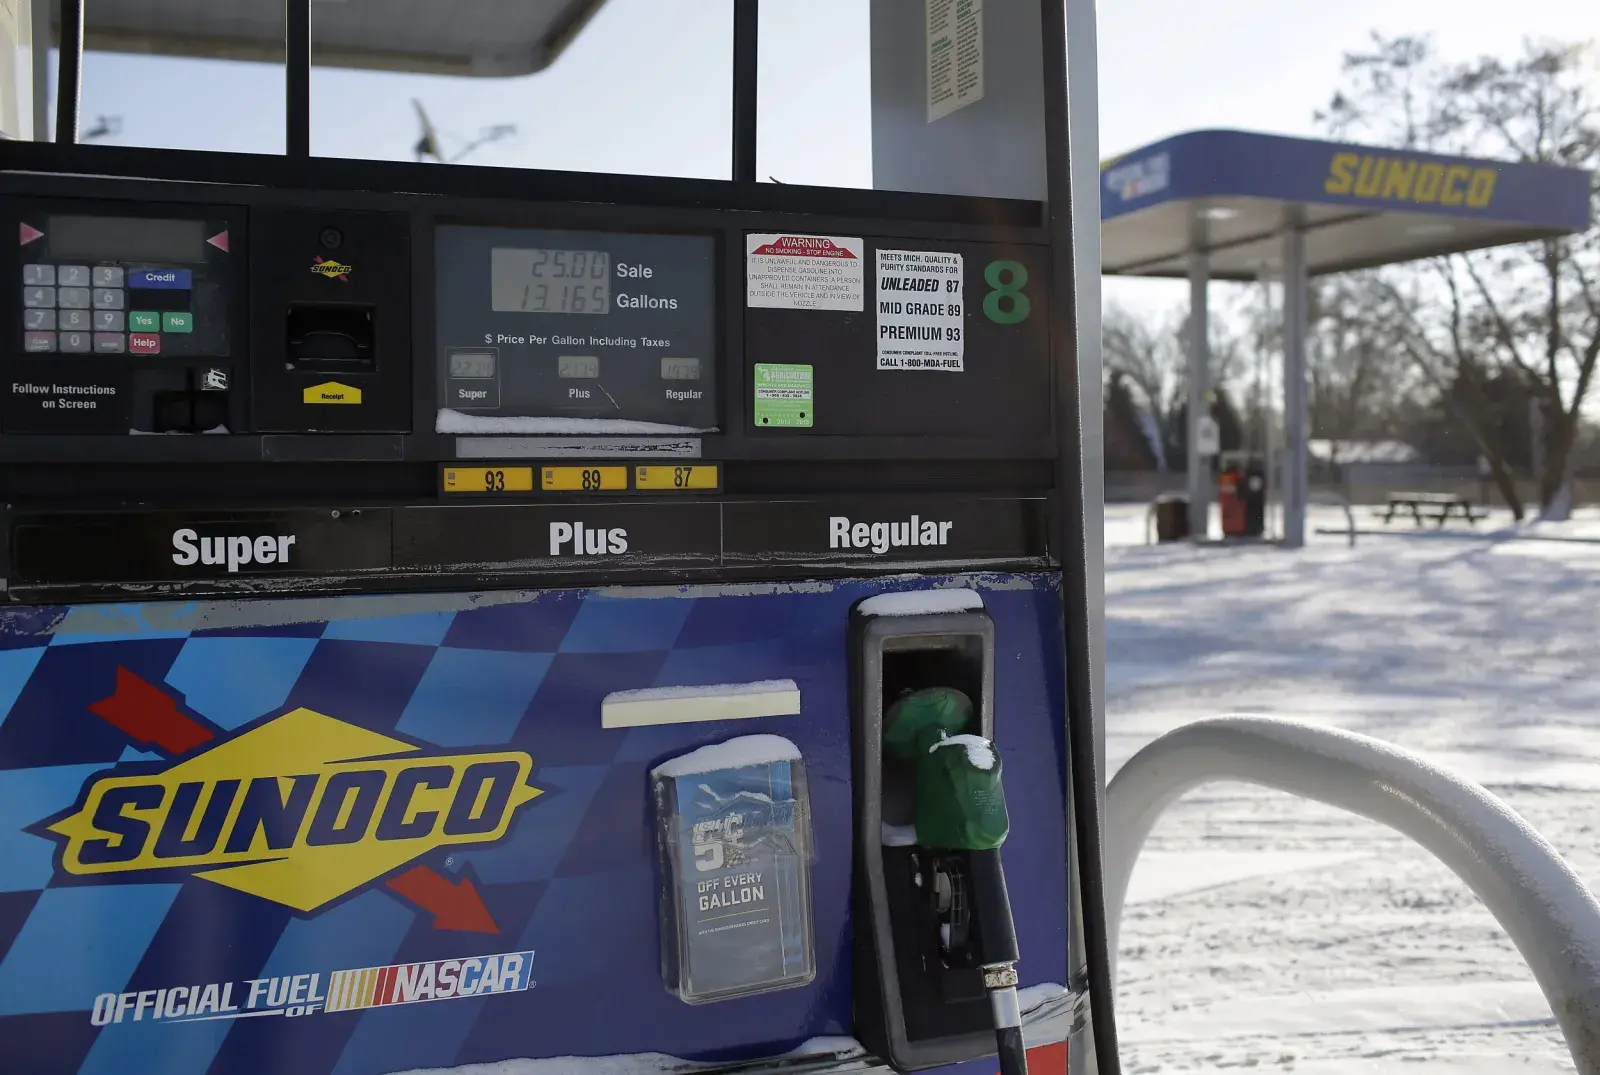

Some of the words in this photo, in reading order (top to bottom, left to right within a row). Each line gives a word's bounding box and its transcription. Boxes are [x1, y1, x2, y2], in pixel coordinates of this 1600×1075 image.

[1325, 152, 1497, 208] SUNOCO
[782, 238, 830, 248] WARNING
[924, 256, 951, 264] QUALITY
[36, 267, 42, 280] 1
[104, 268, 112, 281] 3
[616, 263, 653, 278] Sale
[906, 265, 944, 273] STANDARDS
[146, 273, 175, 282] Credit
[881, 277, 939, 292] UNLEADED
[946, 280, 960, 292] 87
[34, 289, 44, 300] 4
[104, 292, 113, 303] 6
[983, 260, 1030, 324] 8
[616, 294, 678, 310] Gallons
[880, 302, 902, 314] MID
[906, 303, 944, 316] GRADE
[948, 304, 961, 316] 89
[35, 312, 44, 324] 7
[105, 313, 114, 326] 9
[136, 316, 152, 325] Yes
[171, 317, 184, 326] No
[70, 334, 79, 346] 0
[880, 326, 941, 340] PREMIUM
[946, 328, 960, 341] 93
[134, 339, 156, 348] Help
[485, 334, 492, 344] $
[498, 334, 525, 344] Price
[529, 335, 547, 344] Per
[552, 336, 585, 346] Gallon
[590, 336, 637, 348] Including
[641, 337, 670, 347] Taxes
[880, 358, 898, 367] CALL
[900, 359, 960, 368] 1-800-MDA-FUEL
[12, 383, 49, 394] Follow
[53, 384, 116, 394] Instructions
[459, 389, 487, 400] Super
[569, 388, 590, 398] Plus
[666, 389, 702, 400] Regular
[42, 400, 56, 408] on
[58, 399, 96, 409] Screen
[485, 470, 505, 492] 93
[582, 470, 601, 490] 89
[674, 467, 692, 487] 87
[549, 521, 628, 555] Plus
[829, 514, 952, 554] Regular
[172, 528, 296, 572] Super
[77, 760, 521, 864] SUNOCO
[698, 878, 719, 893] OFF
[724, 873, 762, 888] EVERY
[699, 886, 764, 911] GALLON
[392, 954, 524, 1002] NASCAR
[90, 981, 238, 1027] OFFICIAL
[242, 972, 324, 1008] FUEL
[284, 1004, 324, 1017] OF
